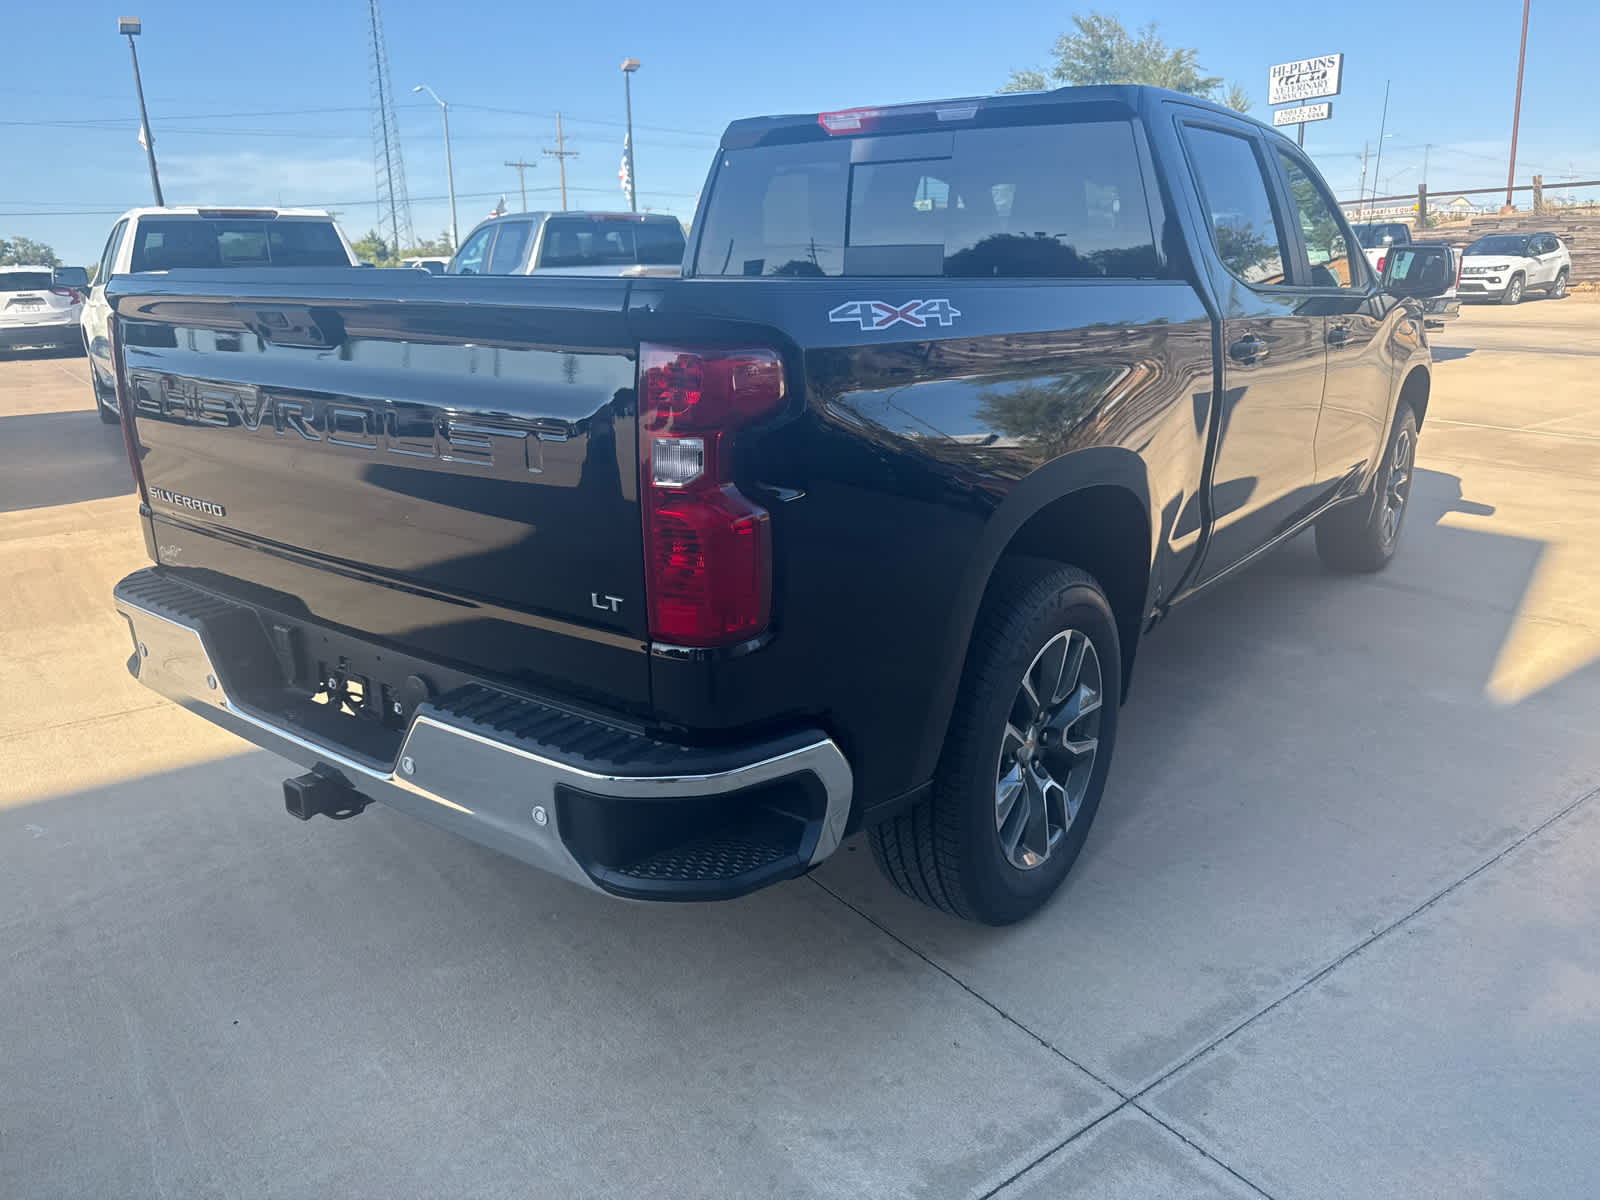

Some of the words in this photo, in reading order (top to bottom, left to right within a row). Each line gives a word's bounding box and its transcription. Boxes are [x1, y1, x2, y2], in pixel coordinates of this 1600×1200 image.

[1272, 56, 1335, 78] HI-PLAINS
[1274, 80, 1328, 95] VETERINARY
[828, 298, 961, 331] 4X4
[132, 372, 569, 474] CHEVROLET
[149, 486, 226, 517] SILVERADO
[591, 592, 624, 612] LT
